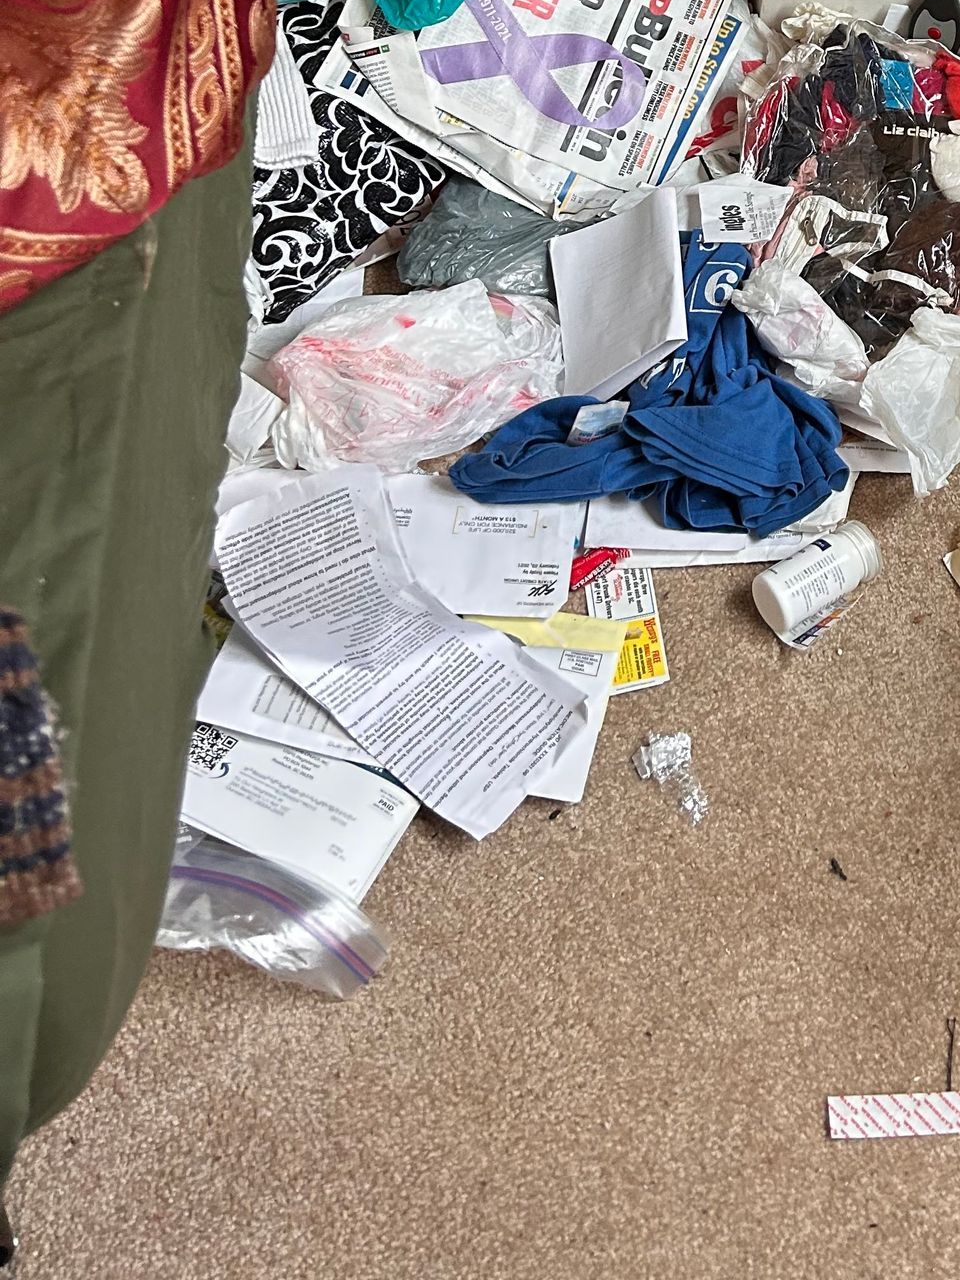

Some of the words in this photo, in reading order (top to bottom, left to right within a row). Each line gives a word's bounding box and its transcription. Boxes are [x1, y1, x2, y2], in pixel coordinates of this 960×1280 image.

[716, 17, 737, 40] Up
[676, 45, 684, 53] TO
[709, 39, 725, 58] to
[661, 56, 672, 72] GAINS
[658, 82, 669, 97] THESE
[640, 92, 657, 121] LONELINESS
[647, 96, 663, 122] PROGRAMS
[631, 128, 642, 142] TAKE
[883, 124, 904, 134] Liz
[628, 140, 637, 149] ON
[636, 131, 648, 149] PHONE
[623, 147, 634, 162] SPAM
[625, 147, 642, 175] COMPANIES
[617, 160, 628, 177] CALLS
[719, 205, 746, 230] ingles
[309, 491, 351, 514] Antidepressant
[281, 509, 310, 525] medicines
[252, 527, 268, 538] other
[267, 521, 281, 531] have
[340, 524, 359, 536] Visual
[240, 533, 253, 543] side
[272, 534, 302, 551] medicines
[344, 537, 362, 548] Never
[348, 551, 361, 561] else
[360, 545, 376, 556] What
[284, 553, 326, 575] antidepressant
[323, 561, 339, 572] need
[340, 556, 349, 565] do
[352, 561, 371, 574] Visual
[302, 570, 318, 581] know
[600, 583, 611, 599] Drunk
[602, 599, 615, 620] Drivers
[635, 598, 644, 613] month
[641, 616, 660, 645] Wendy's
[650, 649, 662, 664] FREE
[449, 658, 484, 690] Antidepressant
[491, 662, 506, 675] What
[479, 676, 490, 686] the
[468, 683, 482, 696] most
[447, 692, 471, 715] important
[482, 698, 507, 723] healthcare
[513, 690, 547, 727] Antidepressant
[544, 709, 575, 742] MEDICATION
[531, 739, 548, 757] GUIDE
[466, 743, 494, 773] Depression
[457, 768, 469, 781] and
[376, 797, 396, 812] PAID
